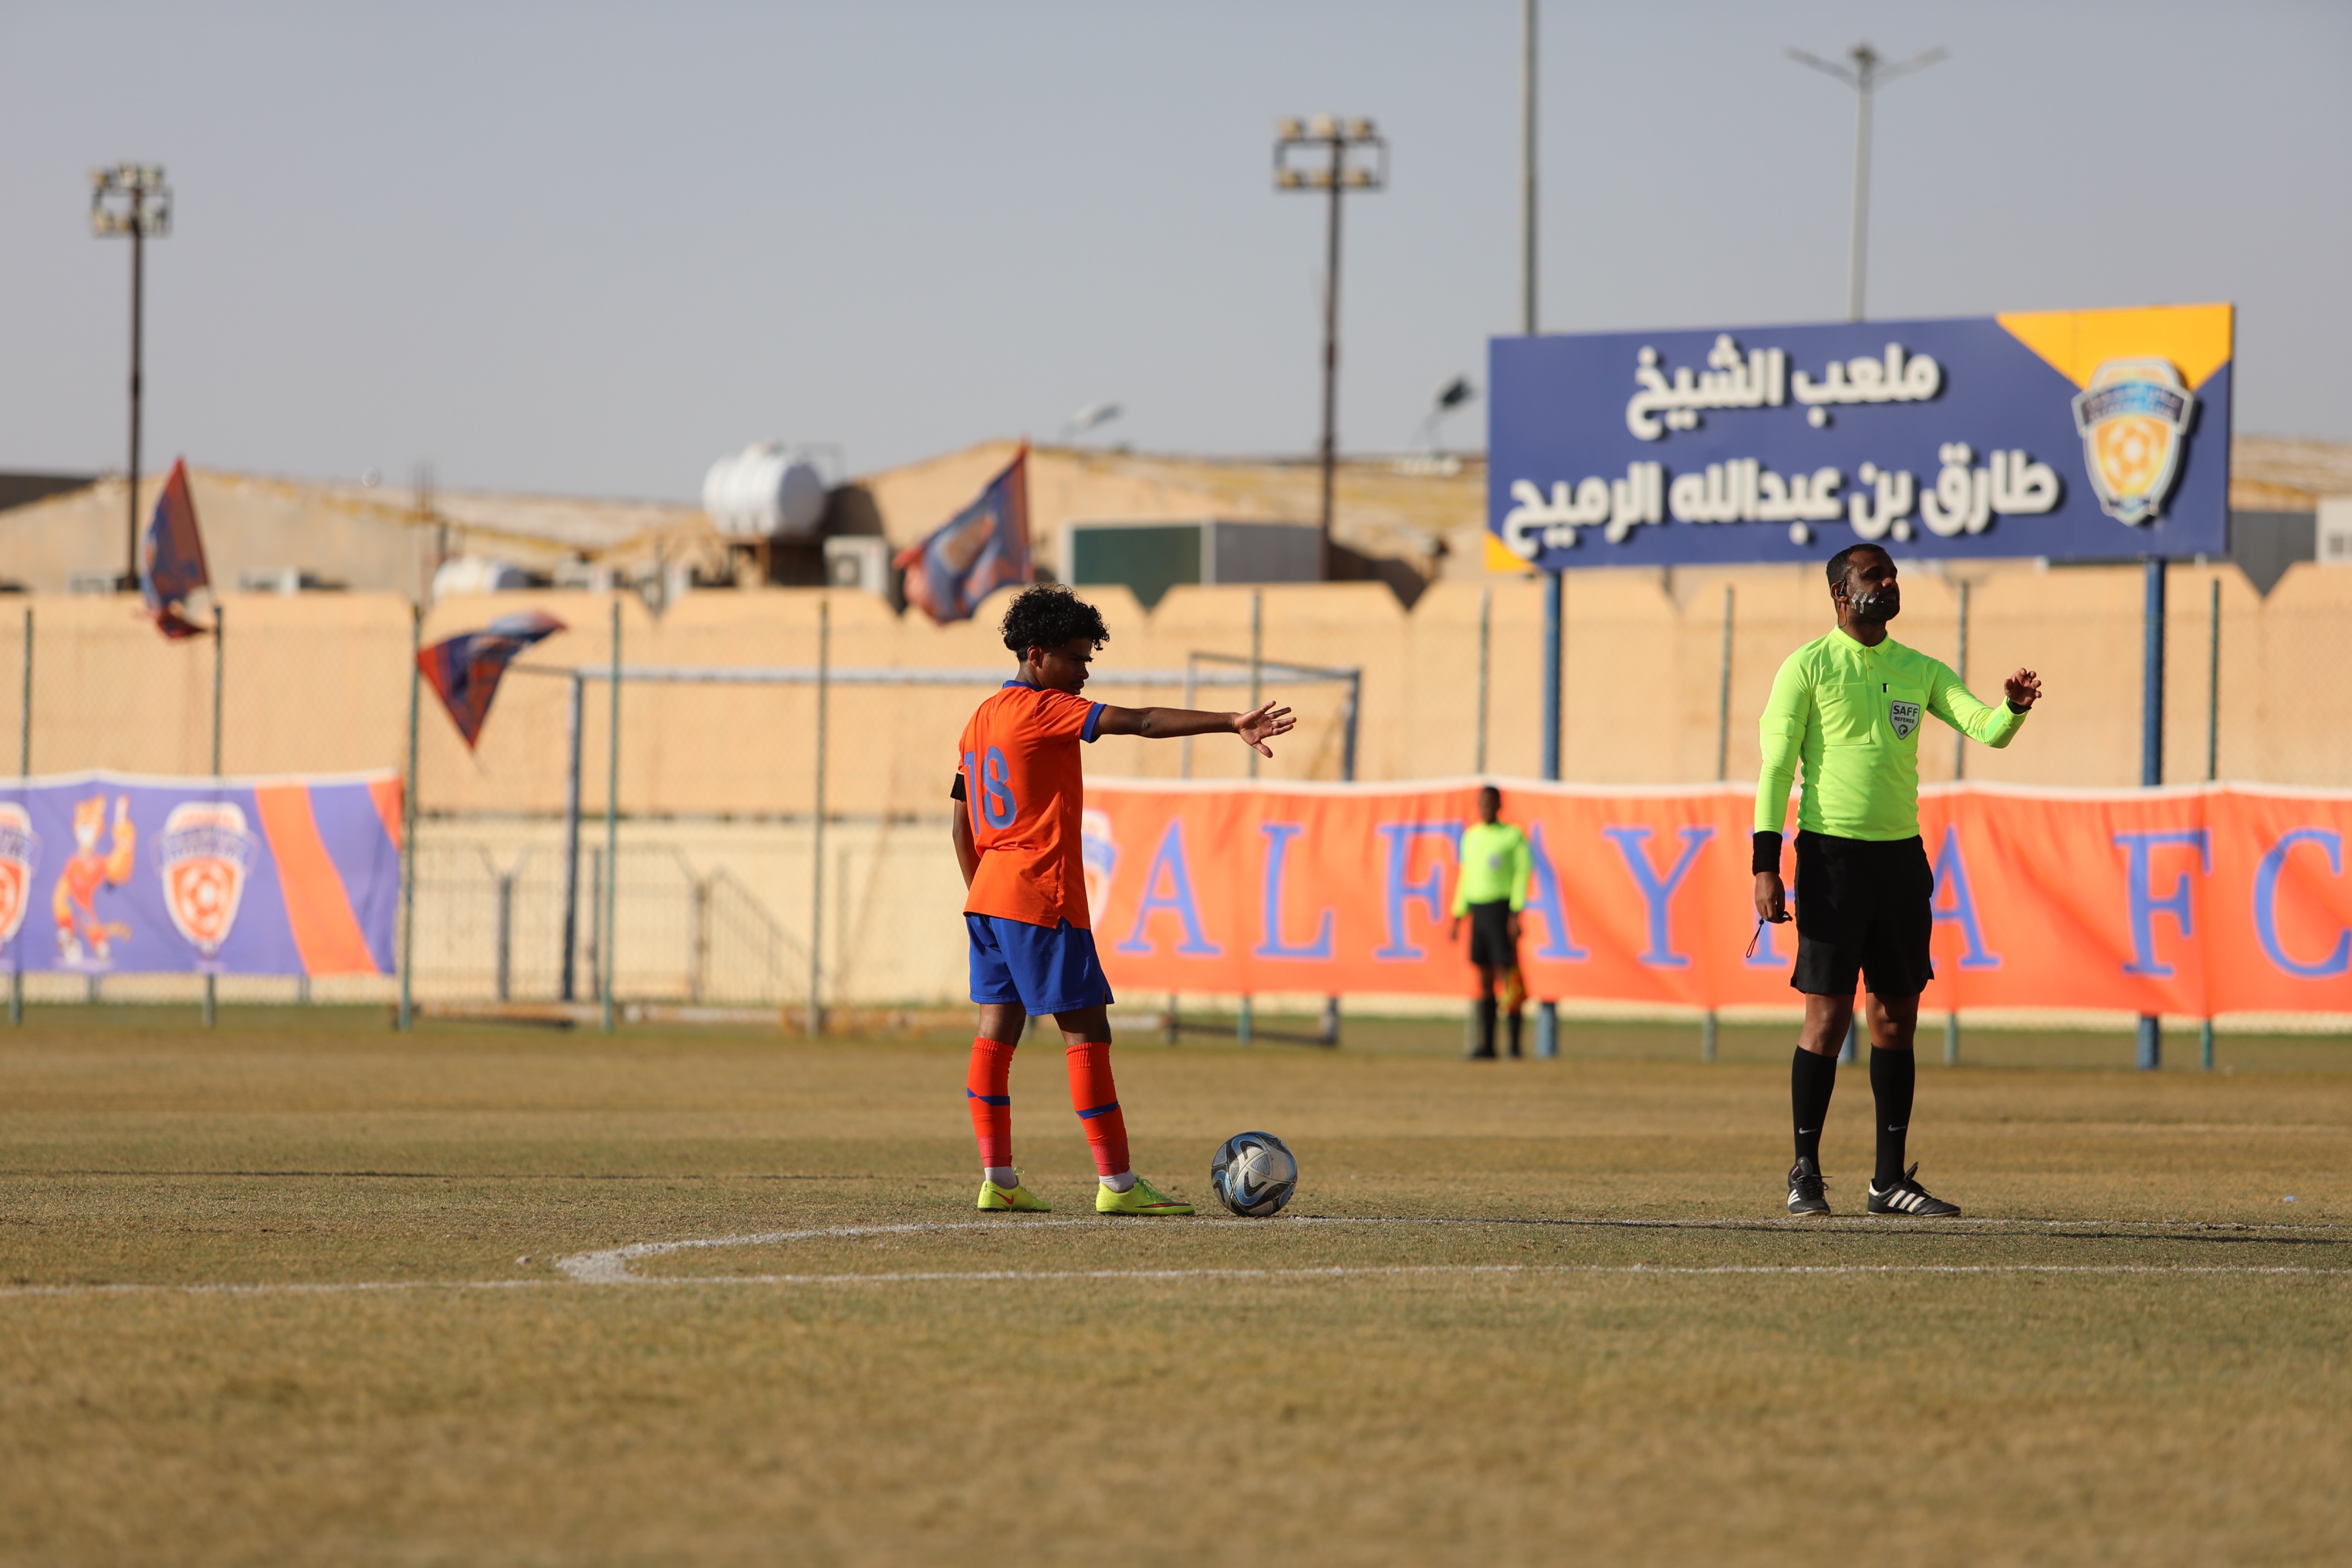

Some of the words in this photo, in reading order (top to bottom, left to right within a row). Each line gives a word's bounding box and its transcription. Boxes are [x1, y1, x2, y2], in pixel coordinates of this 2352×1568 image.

[1626, 333, 1786, 441] الشيخ
[1790, 342, 1940, 428] ملعب
[1502, 460, 1663, 560] الرميح
[1668, 457, 1843, 545] عبدالله
[1848, 461, 1914, 542] بن
[1919, 442, 2059, 537] طارق
[1893, 705, 1918, 717] SAFF
[964, 746, 1017, 836] 18
[2112, 827, 2351, 977] FC
